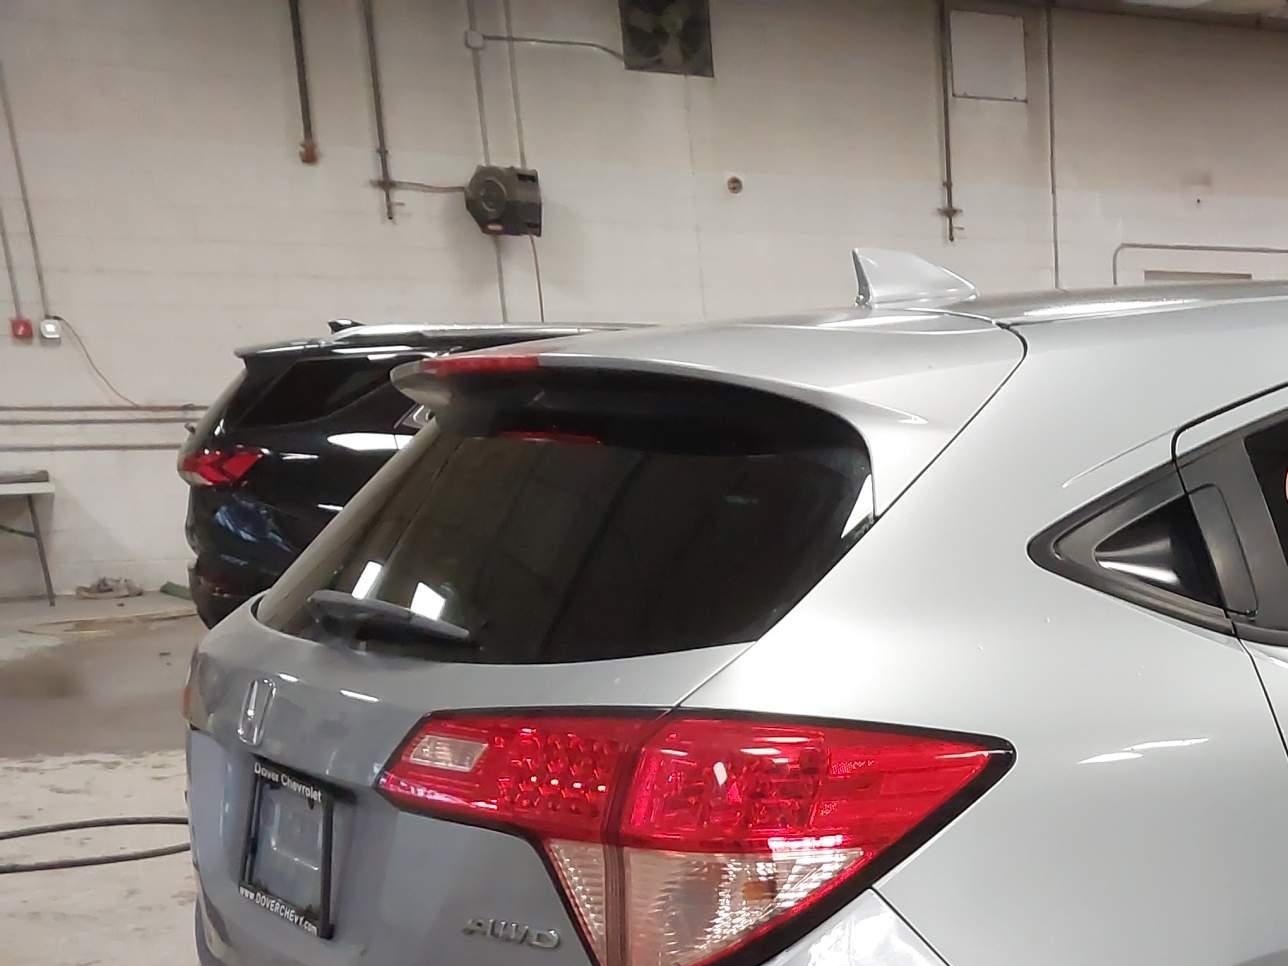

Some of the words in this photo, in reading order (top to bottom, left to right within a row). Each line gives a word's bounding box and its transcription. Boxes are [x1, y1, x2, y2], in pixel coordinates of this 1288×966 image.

[254, 761, 280, 783] Dover
[280, 773, 323, 803] Chevrolet
[462, 918, 561, 950] AWD
